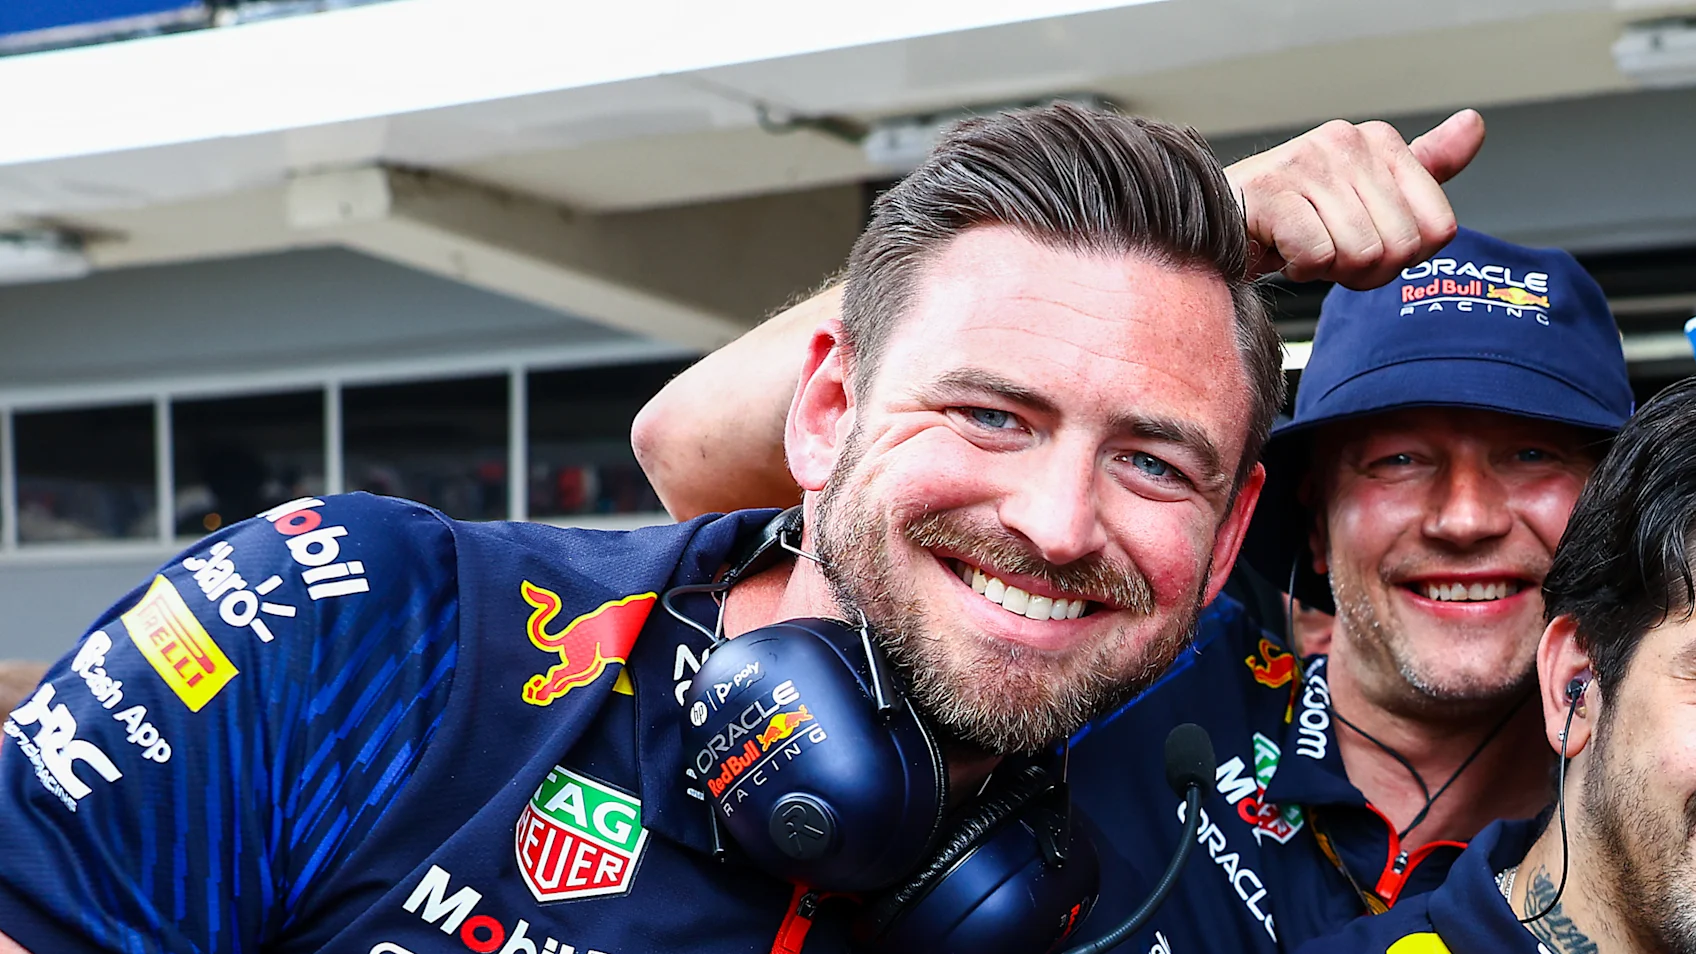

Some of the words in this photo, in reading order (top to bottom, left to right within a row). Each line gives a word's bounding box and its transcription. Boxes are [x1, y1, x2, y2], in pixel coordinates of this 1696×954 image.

[1401, 258, 1549, 292] ORACLE
[1402, 278, 1440, 303] Red
[1442, 279, 1482, 297] Bull
[1400, 302, 1550, 326] RACING
[733, 661, 760, 687] poly
[113, 705, 172, 763] App
[696, 679, 800, 775] ORACLE
[707, 762, 734, 798] Red
[726, 739, 762, 777] Bull
[723, 727, 828, 818] RACING
